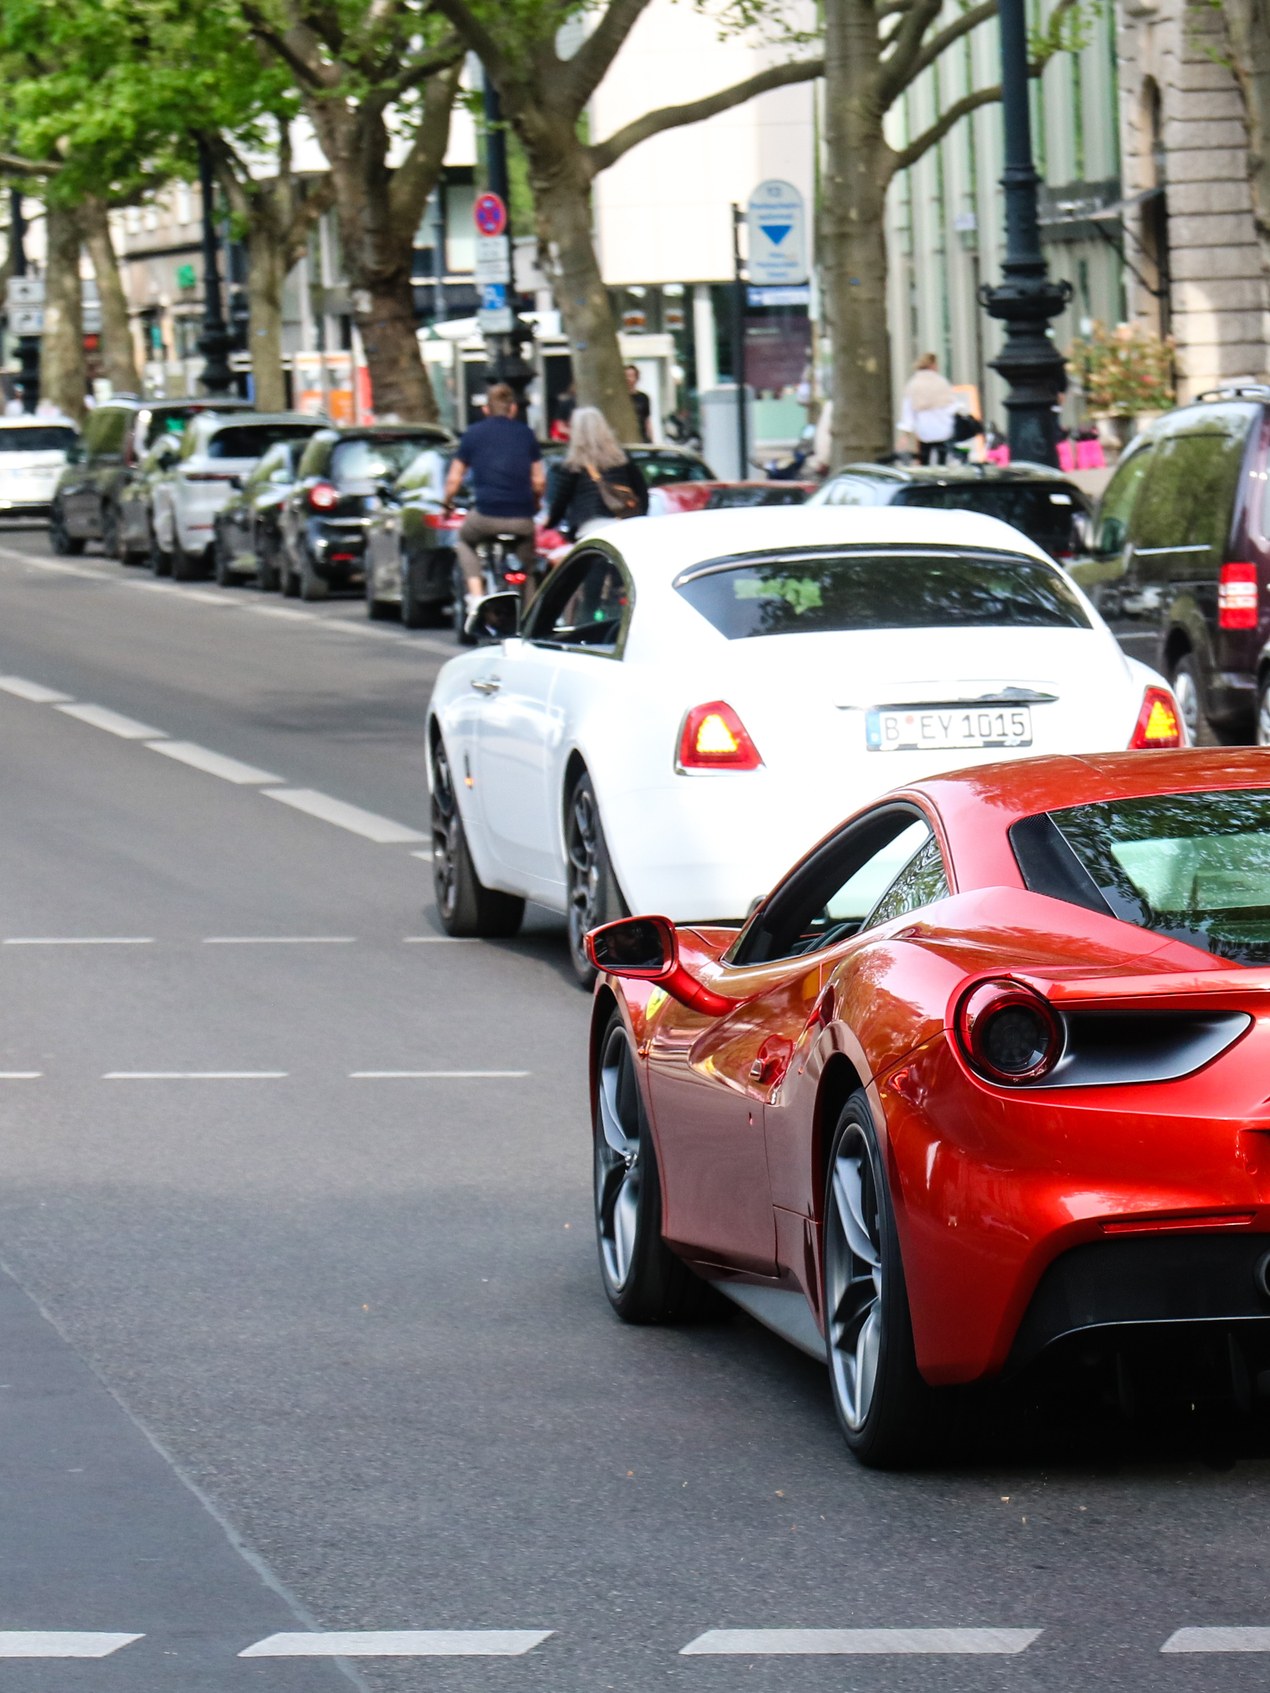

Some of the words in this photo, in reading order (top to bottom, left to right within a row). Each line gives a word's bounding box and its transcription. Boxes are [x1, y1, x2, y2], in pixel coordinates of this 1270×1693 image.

[884, 716, 900, 741] B
[920, 715, 953, 740] EY
[961, 713, 1026, 738] 1015
